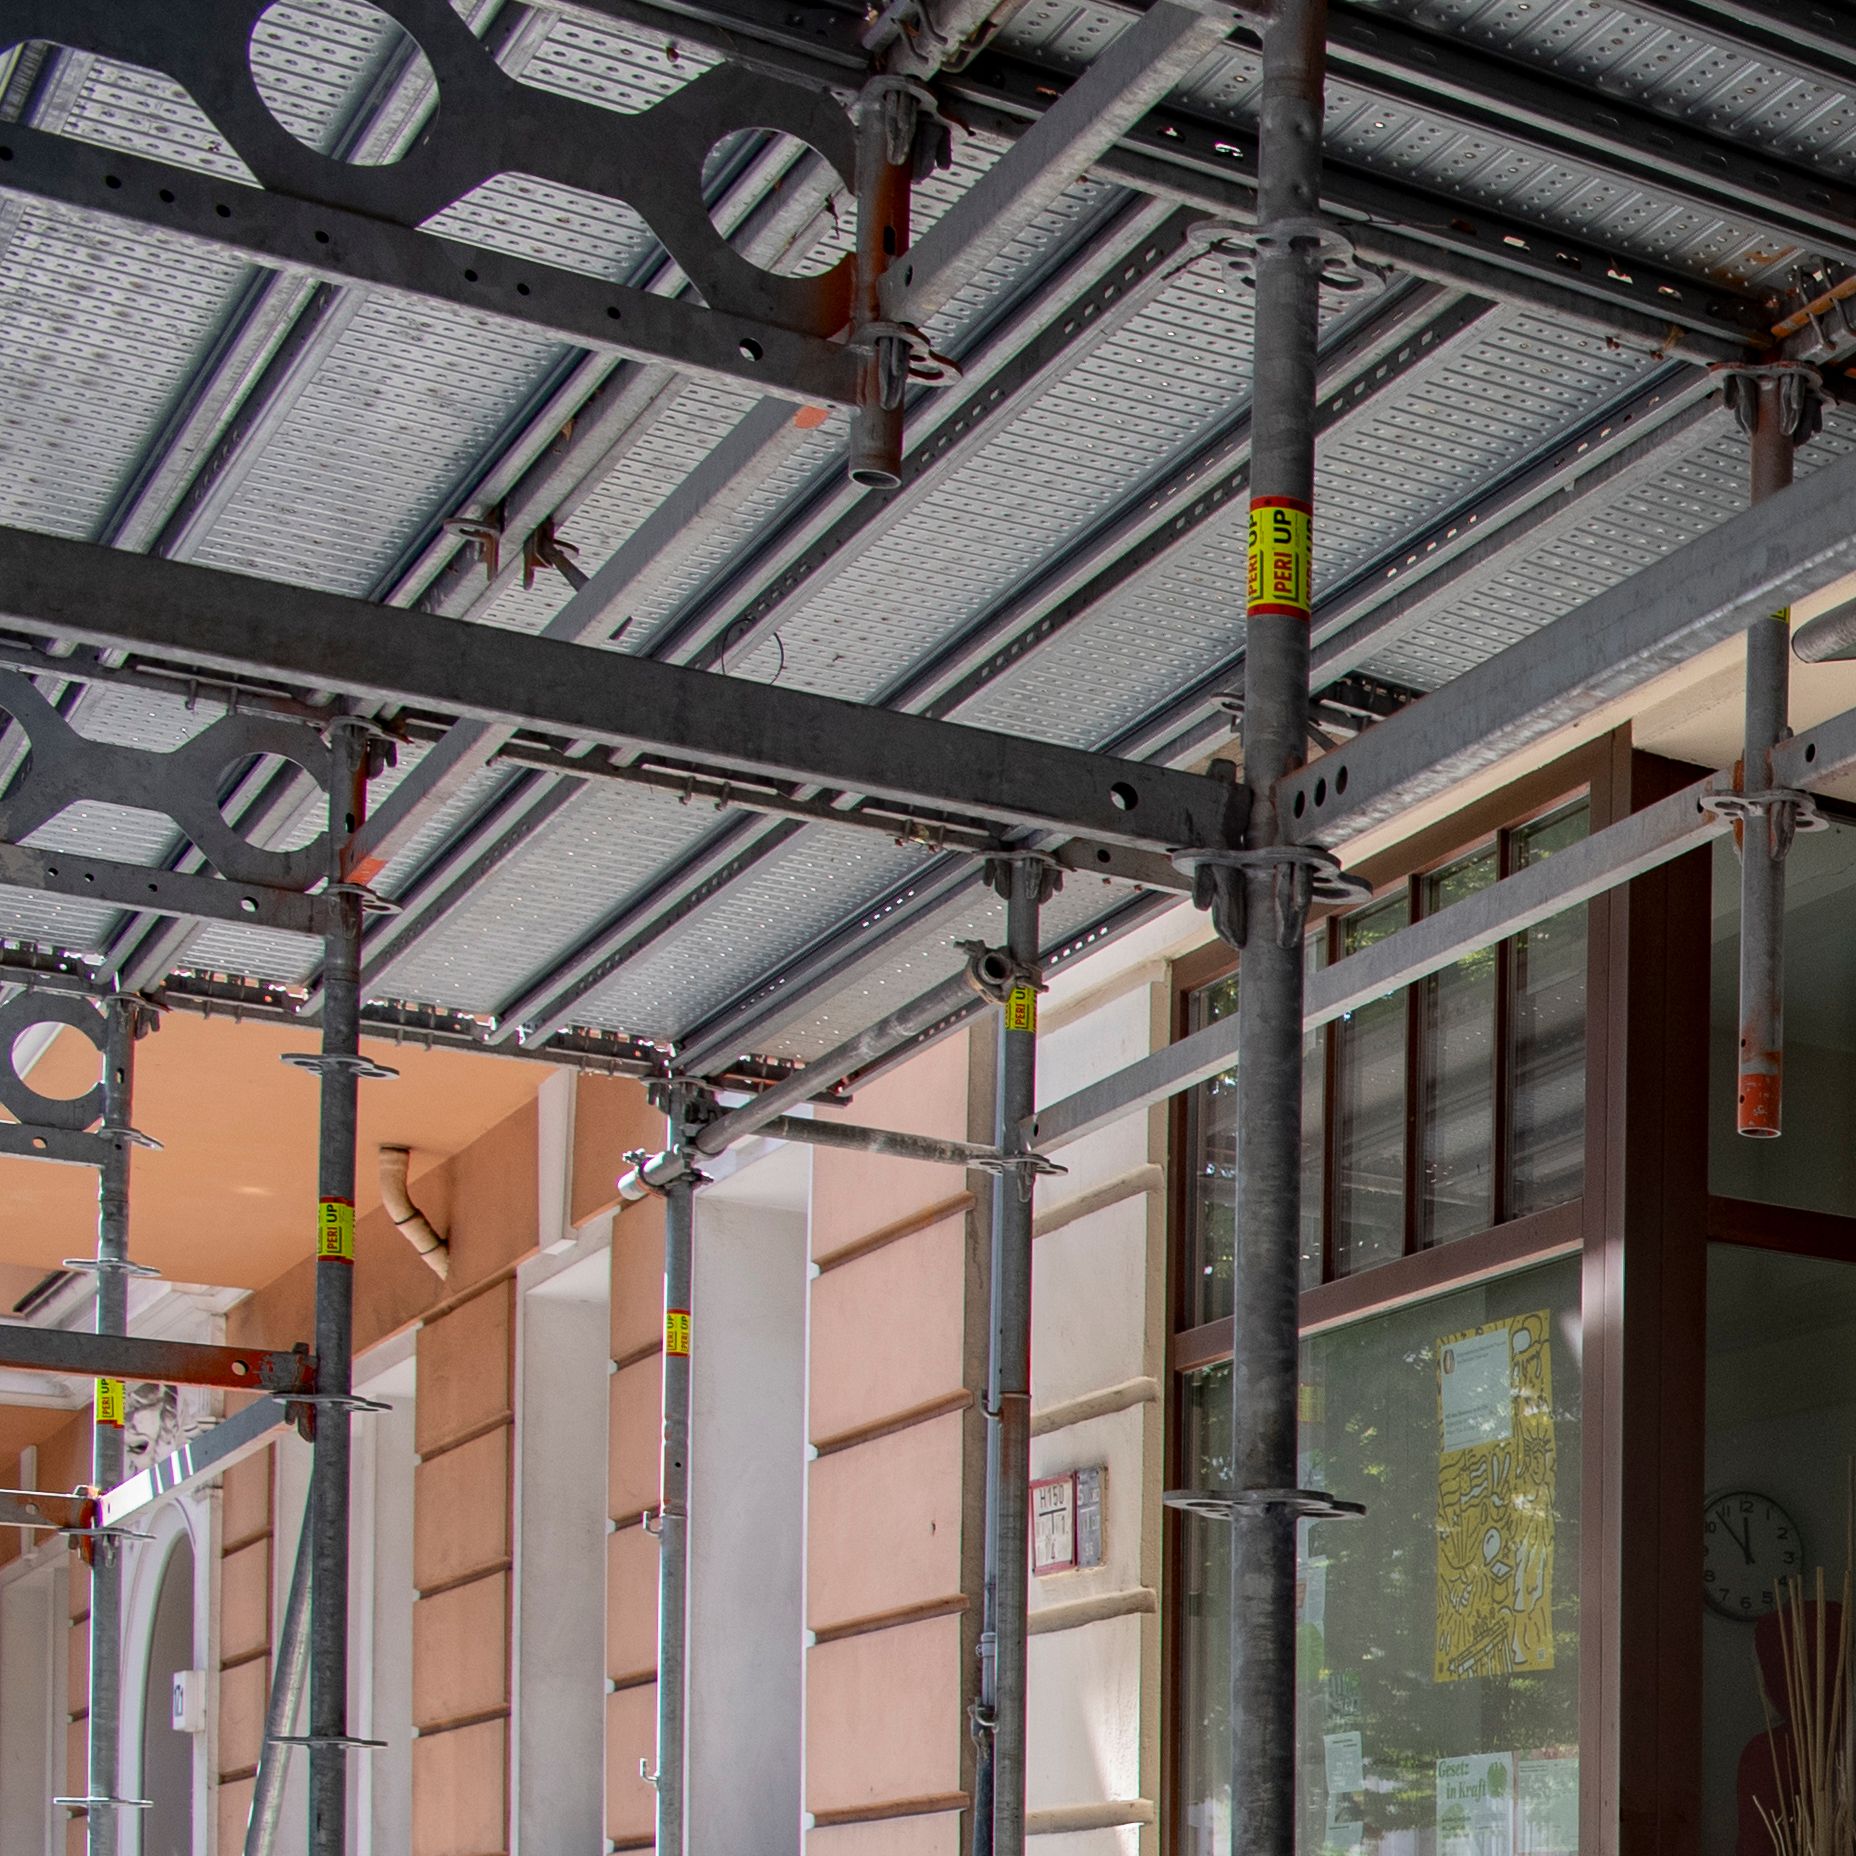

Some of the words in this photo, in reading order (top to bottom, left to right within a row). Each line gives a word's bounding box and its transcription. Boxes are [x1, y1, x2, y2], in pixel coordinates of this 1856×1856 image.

[1273, 509, 1292, 544] UP
[1273, 551, 1293, 594] PERI
[1015, 1003, 1025, 1026] PERI
[326, 1204, 338, 1223] UP
[326, 1226, 338, 1249] PERI
[101, 1378, 109, 1394] UP
[1739, 1500, 1754, 1514] 12
[1777, 1527, 1788, 1540] 2
[1783, 1551, 1795, 1564] 3
[1719, 1588, 1730, 1601] 7
[1740, 1596, 1752, 1610] 6
[1762, 1590, 1773, 1604] 5
[1438, 1760, 1471, 1778] Gesetz
[1446, 1783, 1457, 1799] in
[1458, 1779, 1487, 1803] Kraft
